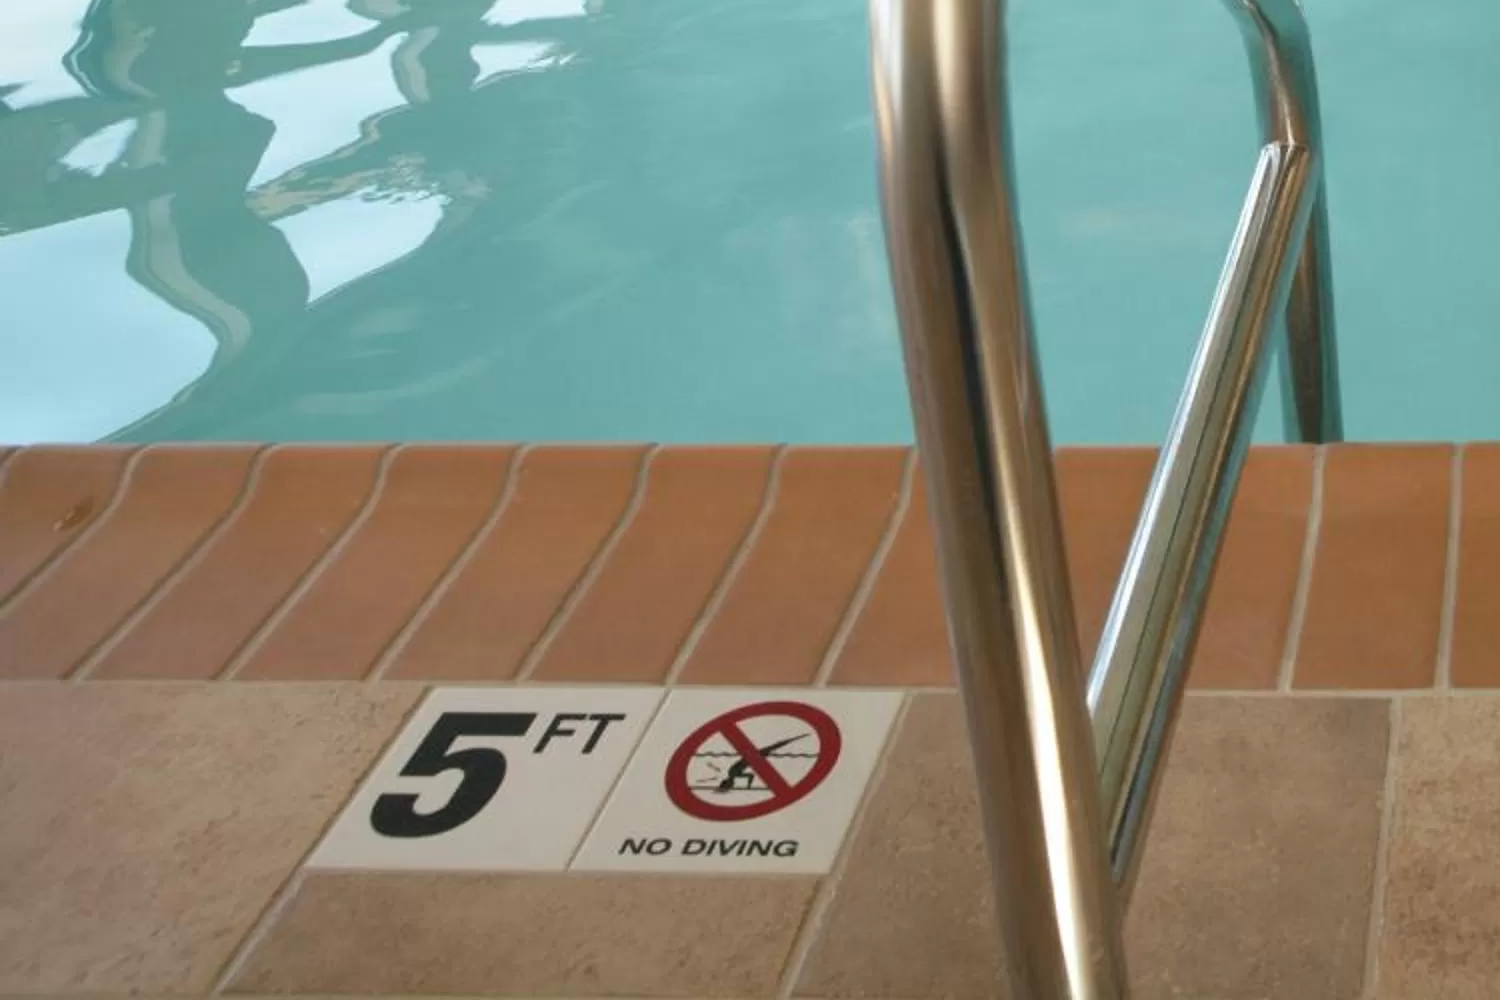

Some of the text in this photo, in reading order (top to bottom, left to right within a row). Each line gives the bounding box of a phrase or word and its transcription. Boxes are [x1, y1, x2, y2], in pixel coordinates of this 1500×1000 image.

[369, 711, 626, 839] 5 FT
[618, 837, 800, 858] NO DIVING
